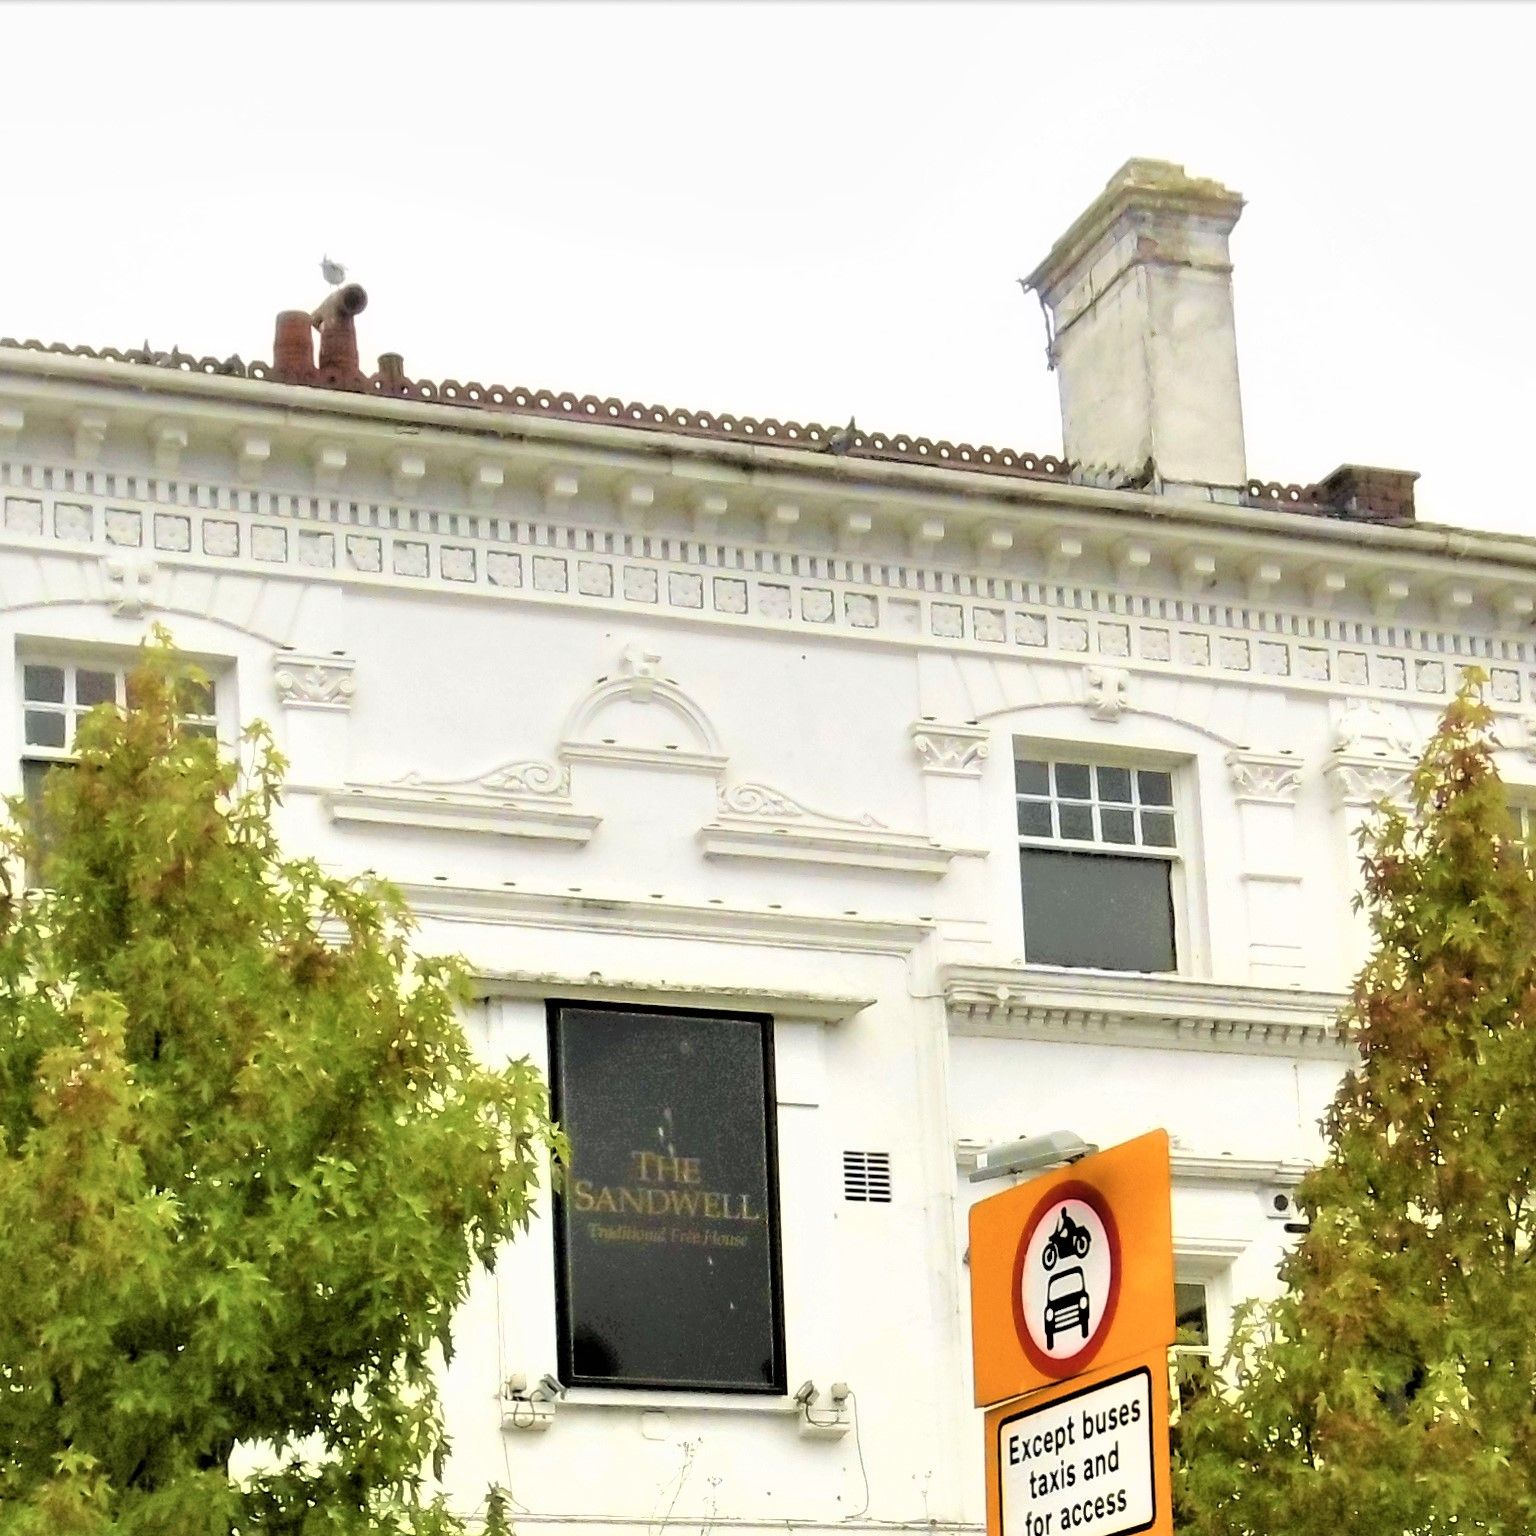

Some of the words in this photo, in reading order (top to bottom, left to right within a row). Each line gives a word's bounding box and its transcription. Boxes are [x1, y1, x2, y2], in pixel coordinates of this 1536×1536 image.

[632, 1151, 701, 1184] THE
[574, 1180, 760, 1221] SANDWELL
[1009, 1416, 1076, 1466] Except
[1082, 1399, 1141, 1440] buses
[1029, 1459, 1076, 1499] taxis
[1083, 1441, 1120, 1481] and
[1060, 1488, 1128, 1530] access
